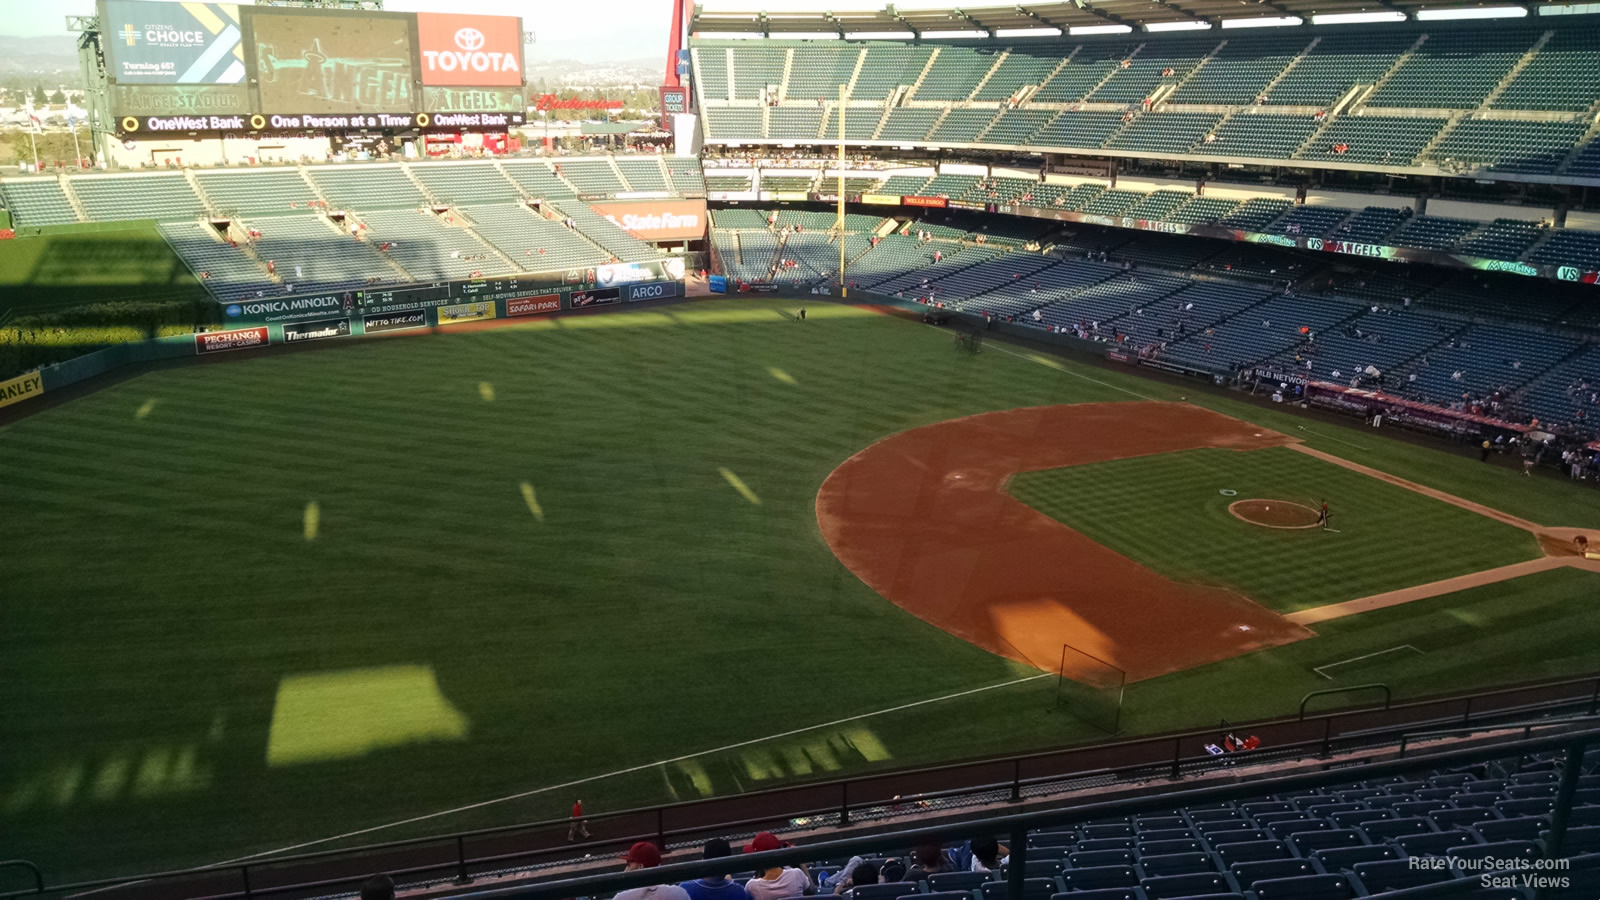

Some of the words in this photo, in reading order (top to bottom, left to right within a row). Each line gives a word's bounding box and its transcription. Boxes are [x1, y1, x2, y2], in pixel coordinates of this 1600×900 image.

[145, 30, 204, 43] CHOICE
[123, 61, 160, 71] Turning
[423, 51, 519, 72] TOYOTA
[129, 91, 177, 109] ANGEL
[179, 93, 240, 109] STADIUM
[436, 88, 498, 110] ANGELS
[533, 93, 624, 111] Budweiser
[147, 116, 209, 131] OneWest
[209, 116, 245, 129] Bank
[271, 115, 299, 128] One
[303, 115, 348, 127] Person
[351, 115, 366, 126] at
[367, 117, 376, 126] a
[378, 114, 411, 126] Time
[434, 114, 480, 126] OneWest
[481, 113, 508, 125] Bank
[906, 196, 924, 204] WELLS
[925, 198, 945, 206] FARGO
[622, 213, 661, 230] State
[661, 212, 698, 229] Farm
[1143, 219, 1177, 233] ANGELS
[1311, 239, 1322, 250] VS
[1334, 241, 1382, 257] ANGELS
[1562, 268, 1577, 280] VS
[483, 291, 516, 300] SELF-MOVING
[632, 285, 662, 299] ARCO
[243, 304, 289, 315] KONICA
[290, 296, 339, 310] MINOLTA
[382, 302, 419, 312] HOUSEHOLD
[420, 299, 448, 307] SERVICES
[443, 304, 470, 316] SHOCK
[474, 303, 490, 312] TOP
[510, 304, 537, 313] SAFARI
[538, 301, 558, 310] PARK
[265, 309, 340, 322] CountOnKonicaMinolta.com
[366, 317, 388, 328] NITTO
[390, 314, 424, 325] TIRE.COM
[204, 330, 262, 344] PECHANGA
[286, 328, 338, 341] Thermador
[206, 343, 232, 351] RESORT
[237, 339, 261, 347] CASINO
[1255, 369, 1271, 378] MLB
